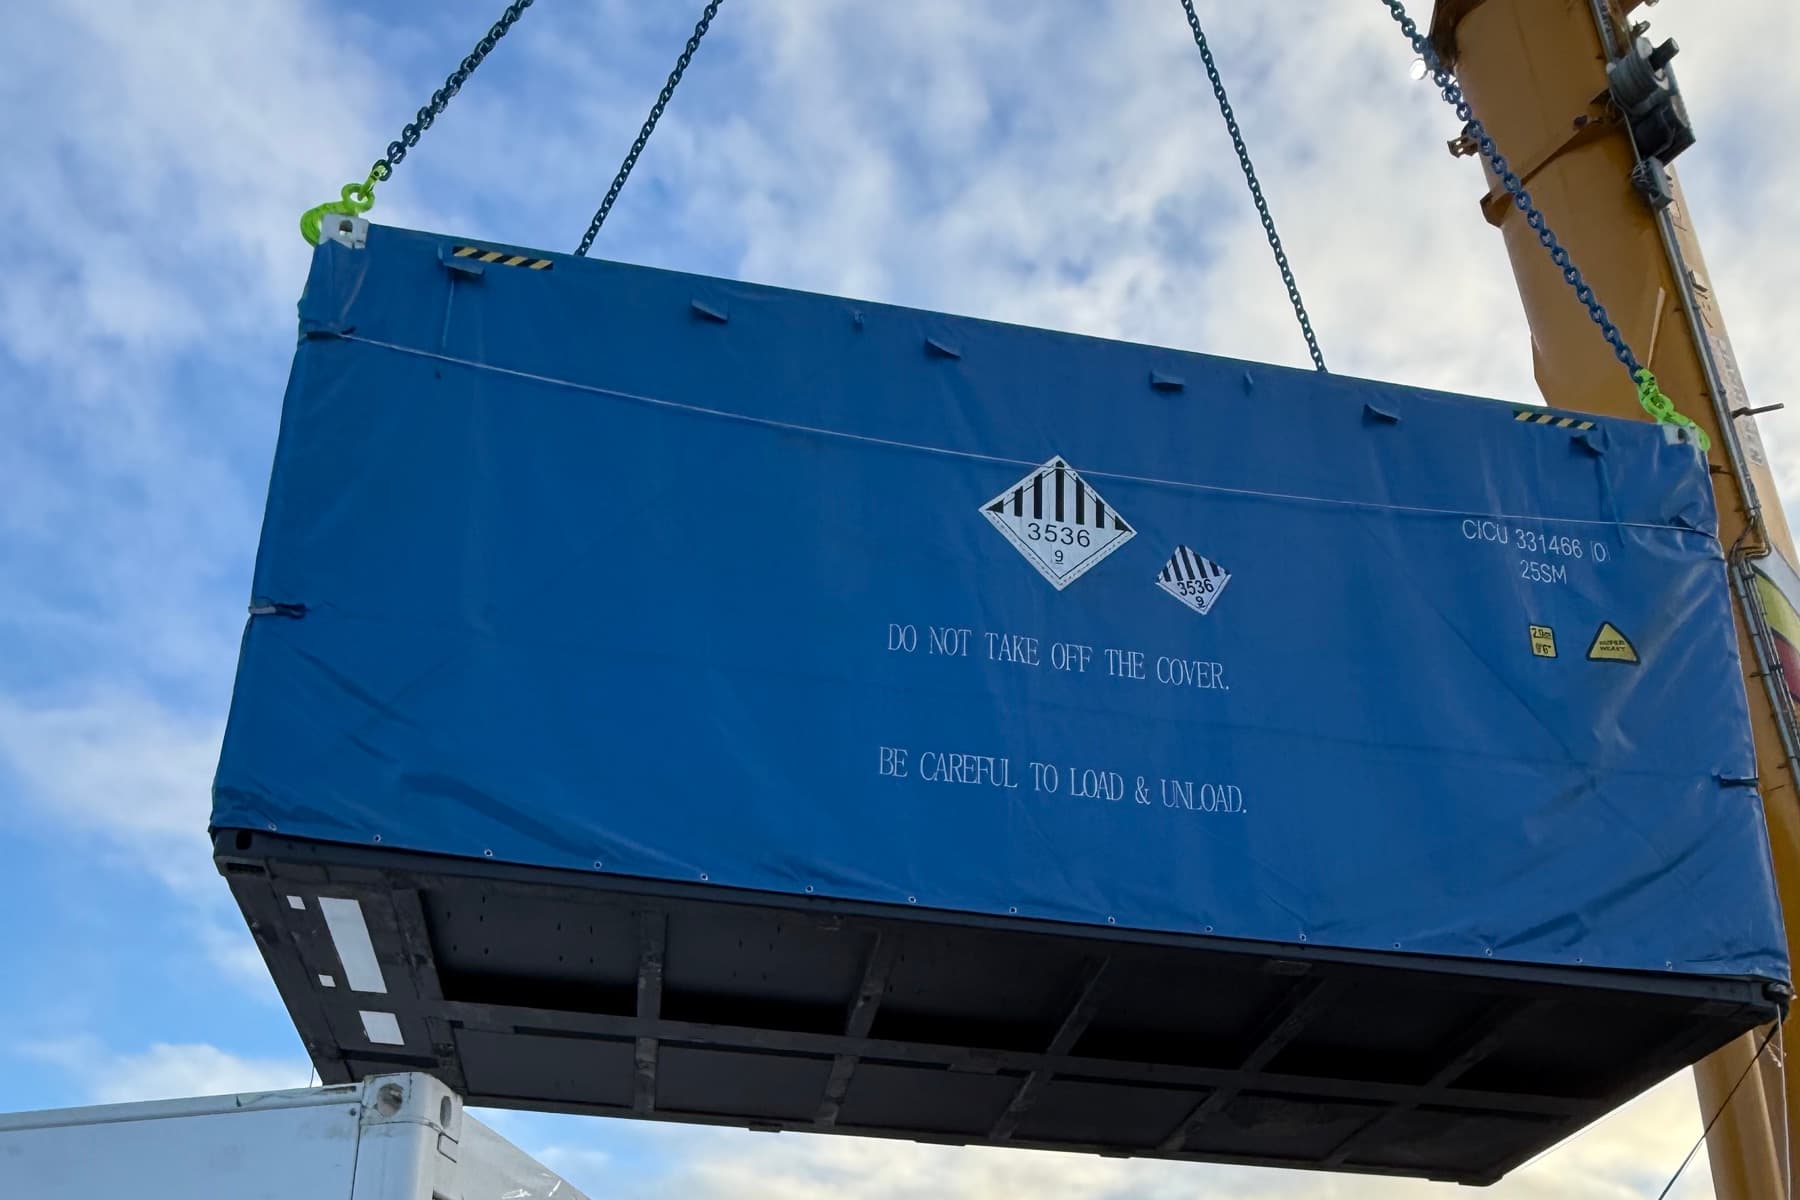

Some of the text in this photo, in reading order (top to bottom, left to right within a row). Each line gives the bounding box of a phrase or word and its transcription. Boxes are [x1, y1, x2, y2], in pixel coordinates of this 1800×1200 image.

[1027, 522, 1091, 548] 3536
[1462, 519, 1508, 545] CICU
[1515, 529, 1583, 559] 331466
[1054, 550, 1064, 563] 9
[1177, 578, 1214, 596] 3536
[1195, 596, 1205, 607] 9
[887, 623, 1231, 691] DO NOT TAKE OFF THE COVER.
[879, 746, 1248, 814] BE CAREFUL TO LOAD & UNLOAD.
